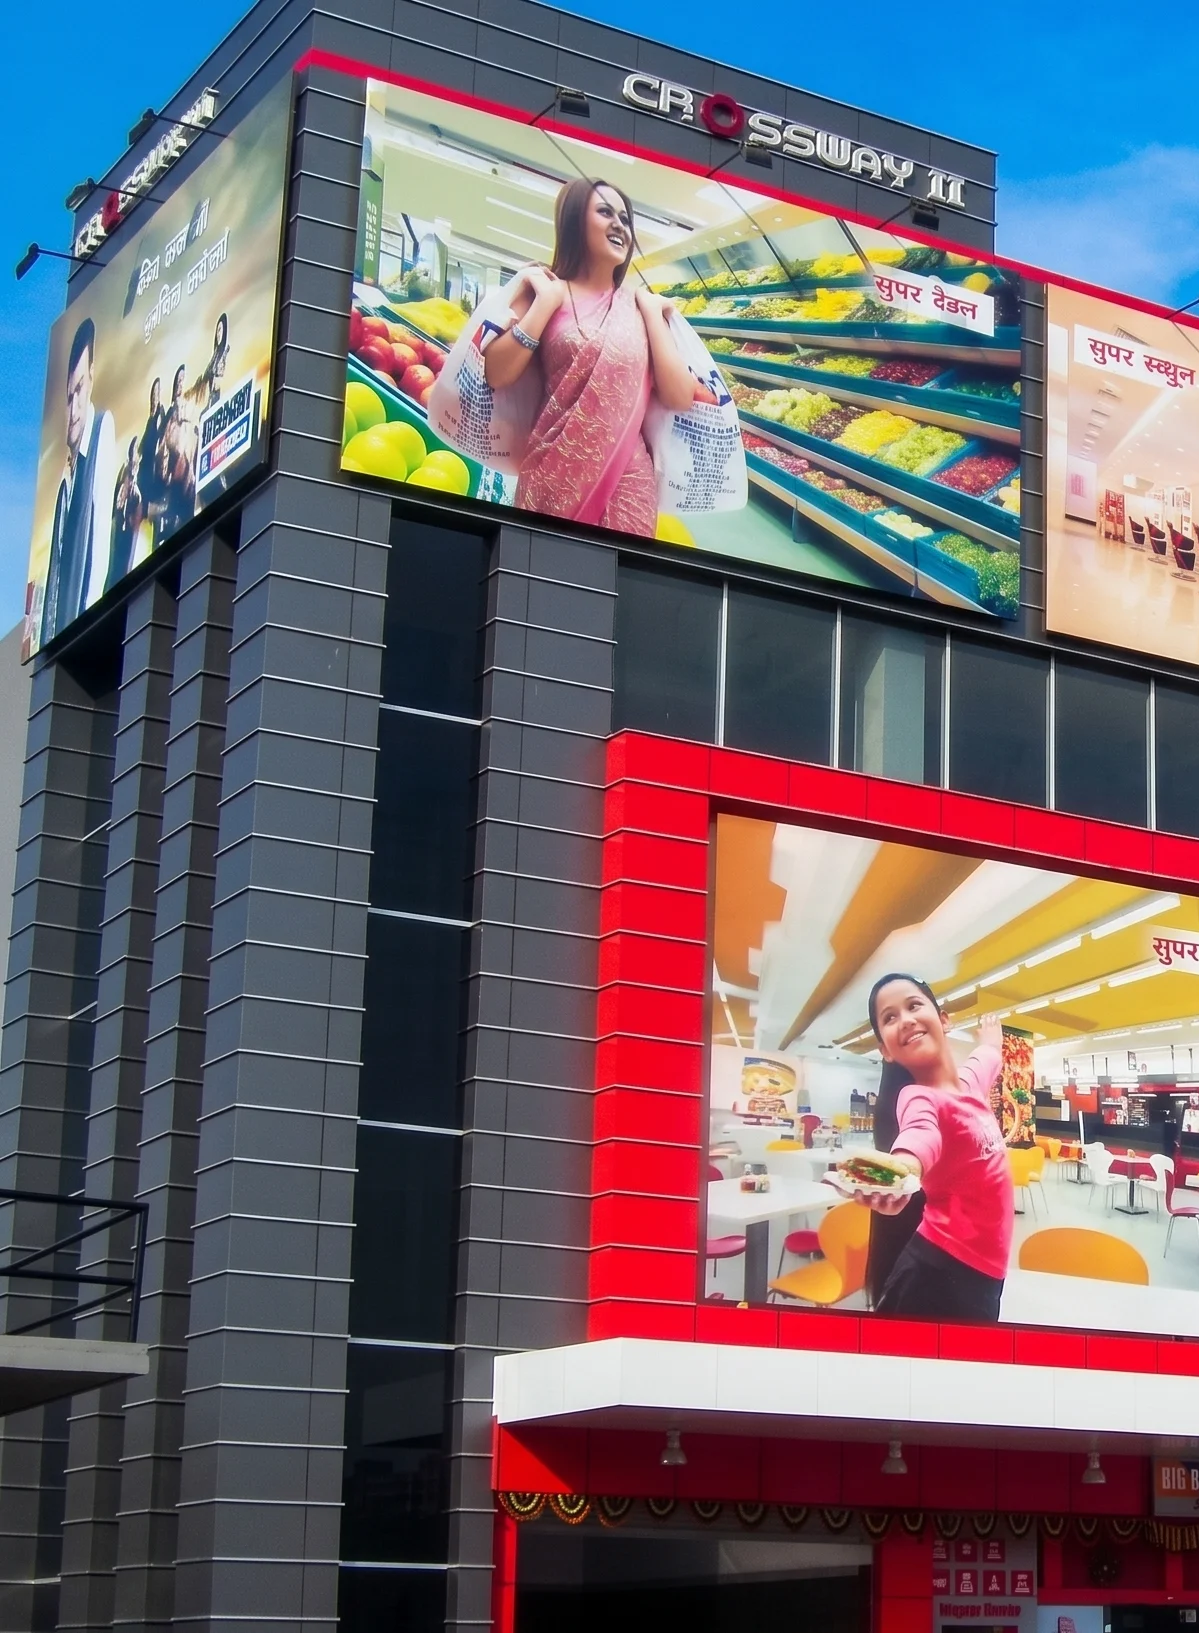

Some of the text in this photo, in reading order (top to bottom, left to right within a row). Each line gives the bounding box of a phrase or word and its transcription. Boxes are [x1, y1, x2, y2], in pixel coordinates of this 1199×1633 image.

[622, 73, 914, 189] CROSSWAY
[873, 274, 923, 304] सुपर
[1087, 337, 1135, 367] सुपर
[1152, 936, 1199, 966] सुपर
[1162, 1467, 1186, 1490] BIG
